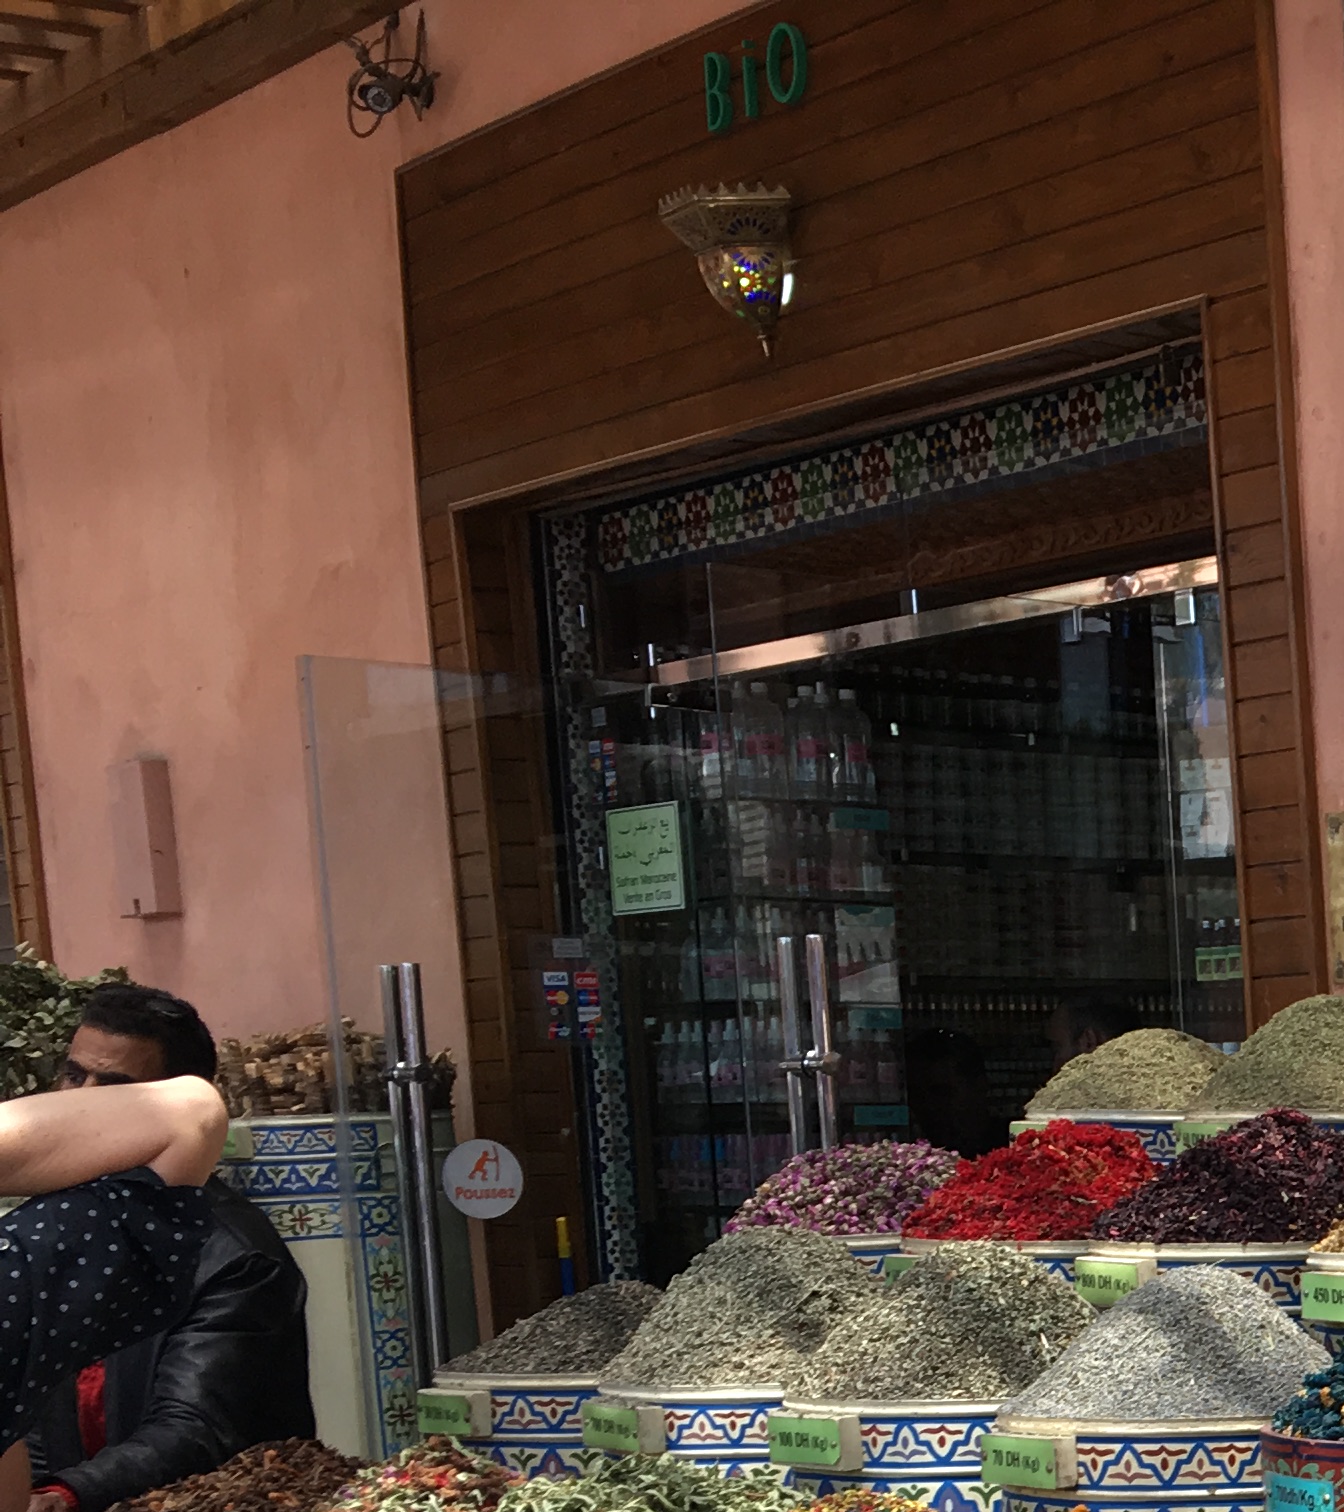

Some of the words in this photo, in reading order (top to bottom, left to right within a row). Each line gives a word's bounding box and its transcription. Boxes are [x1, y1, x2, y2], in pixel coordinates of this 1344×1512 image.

[455, 1187, 515, 1200] Poussez
[1098, 1275, 1112, 1290] DH
[1313, 1288, 1329, 1304] 450
[795, 1432, 810, 1448] DH
[992, 1449, 1003, 1466] 70
[1005, 1451, 1020, 1468] DH
